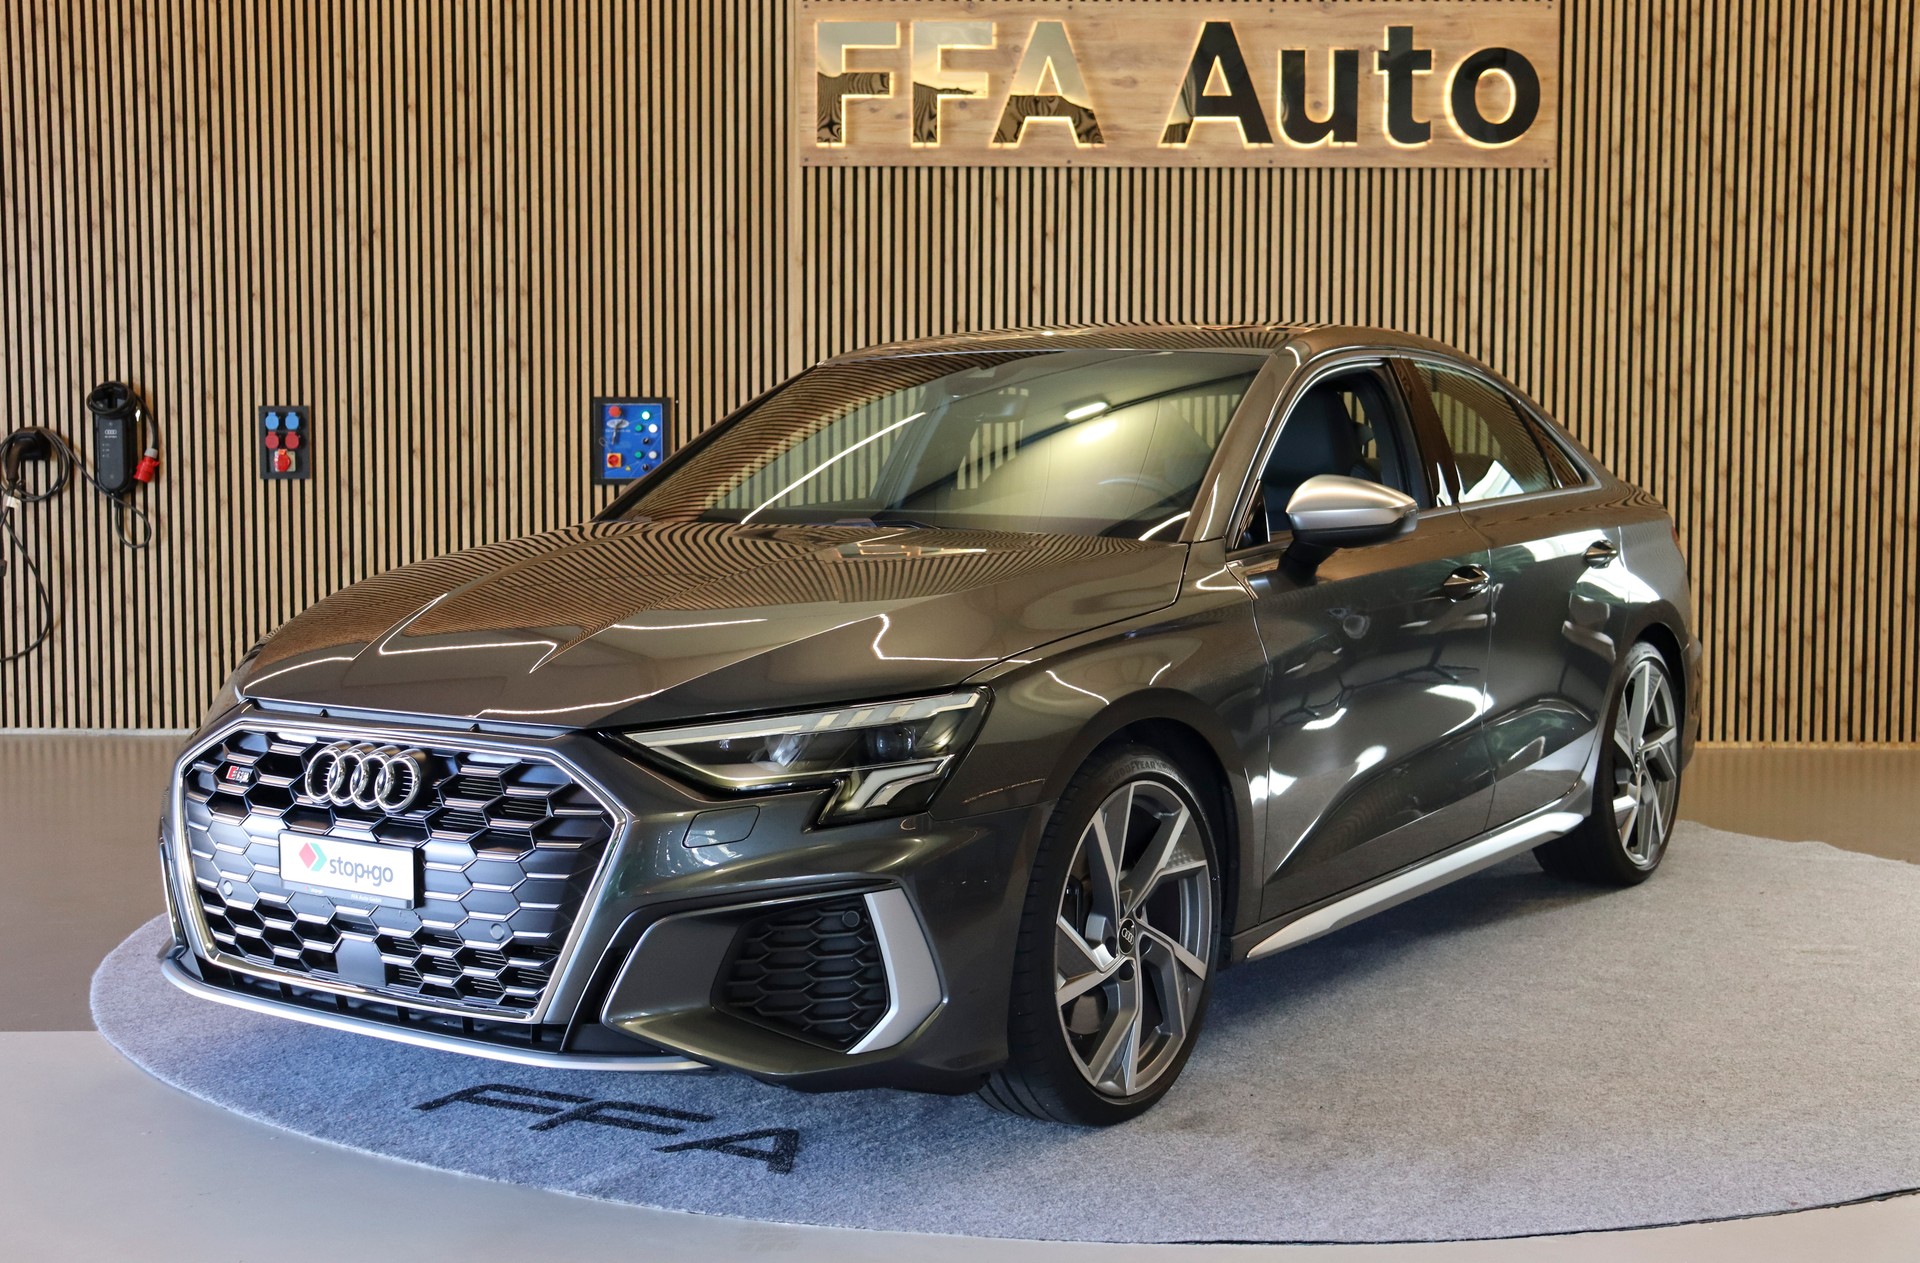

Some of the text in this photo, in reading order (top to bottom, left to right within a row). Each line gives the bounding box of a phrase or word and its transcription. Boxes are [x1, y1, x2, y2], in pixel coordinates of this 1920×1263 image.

[816, 21, 1541, 146] FFA Auto
[1108, 759, 1157, 784] GOODYEAR
[330, 856, 394, 887] stop+go
[411, 1083, 800, 1174] FFA
